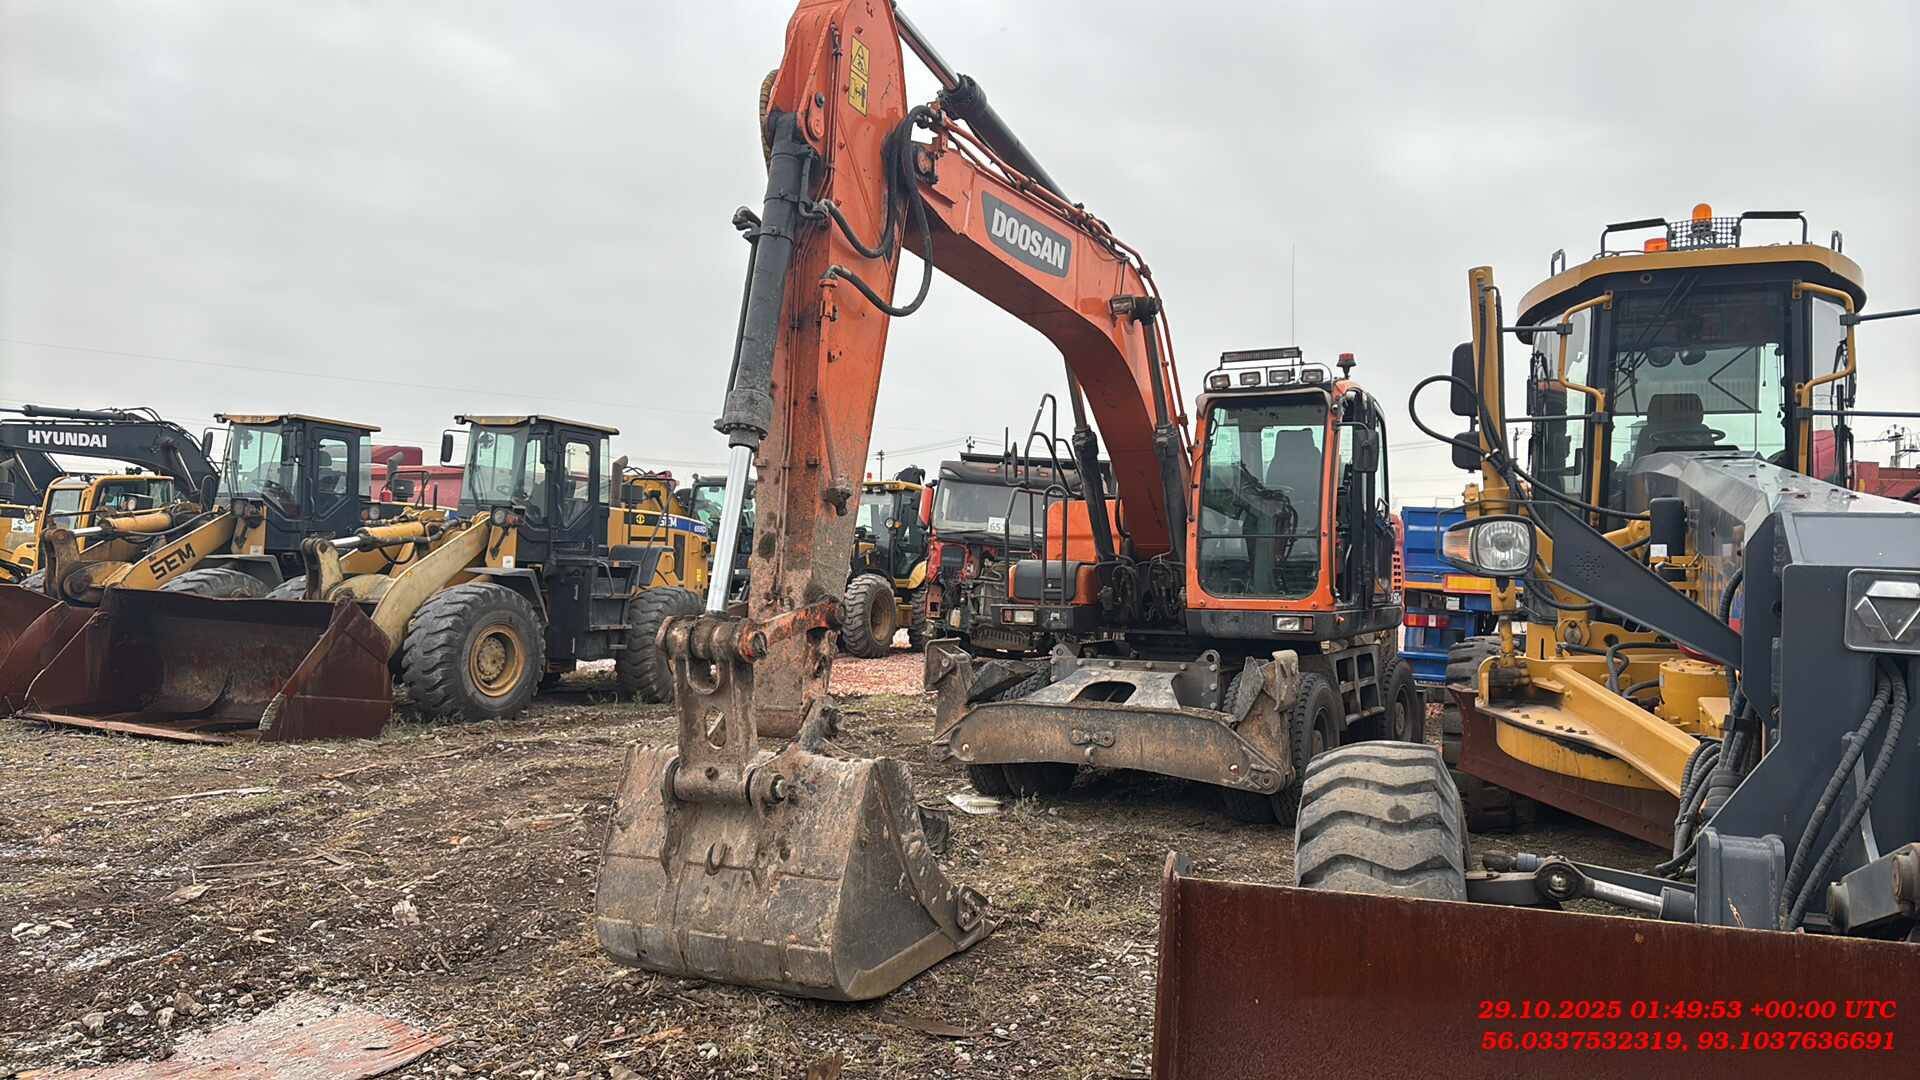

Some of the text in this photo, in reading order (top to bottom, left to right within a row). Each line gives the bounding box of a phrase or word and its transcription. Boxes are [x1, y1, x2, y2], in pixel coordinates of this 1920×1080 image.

[991, 207, 1066, 270] DOOSAN
[27, 429, 107, 448] HYUNDAI
[150, 542, 196, 580] SEM
